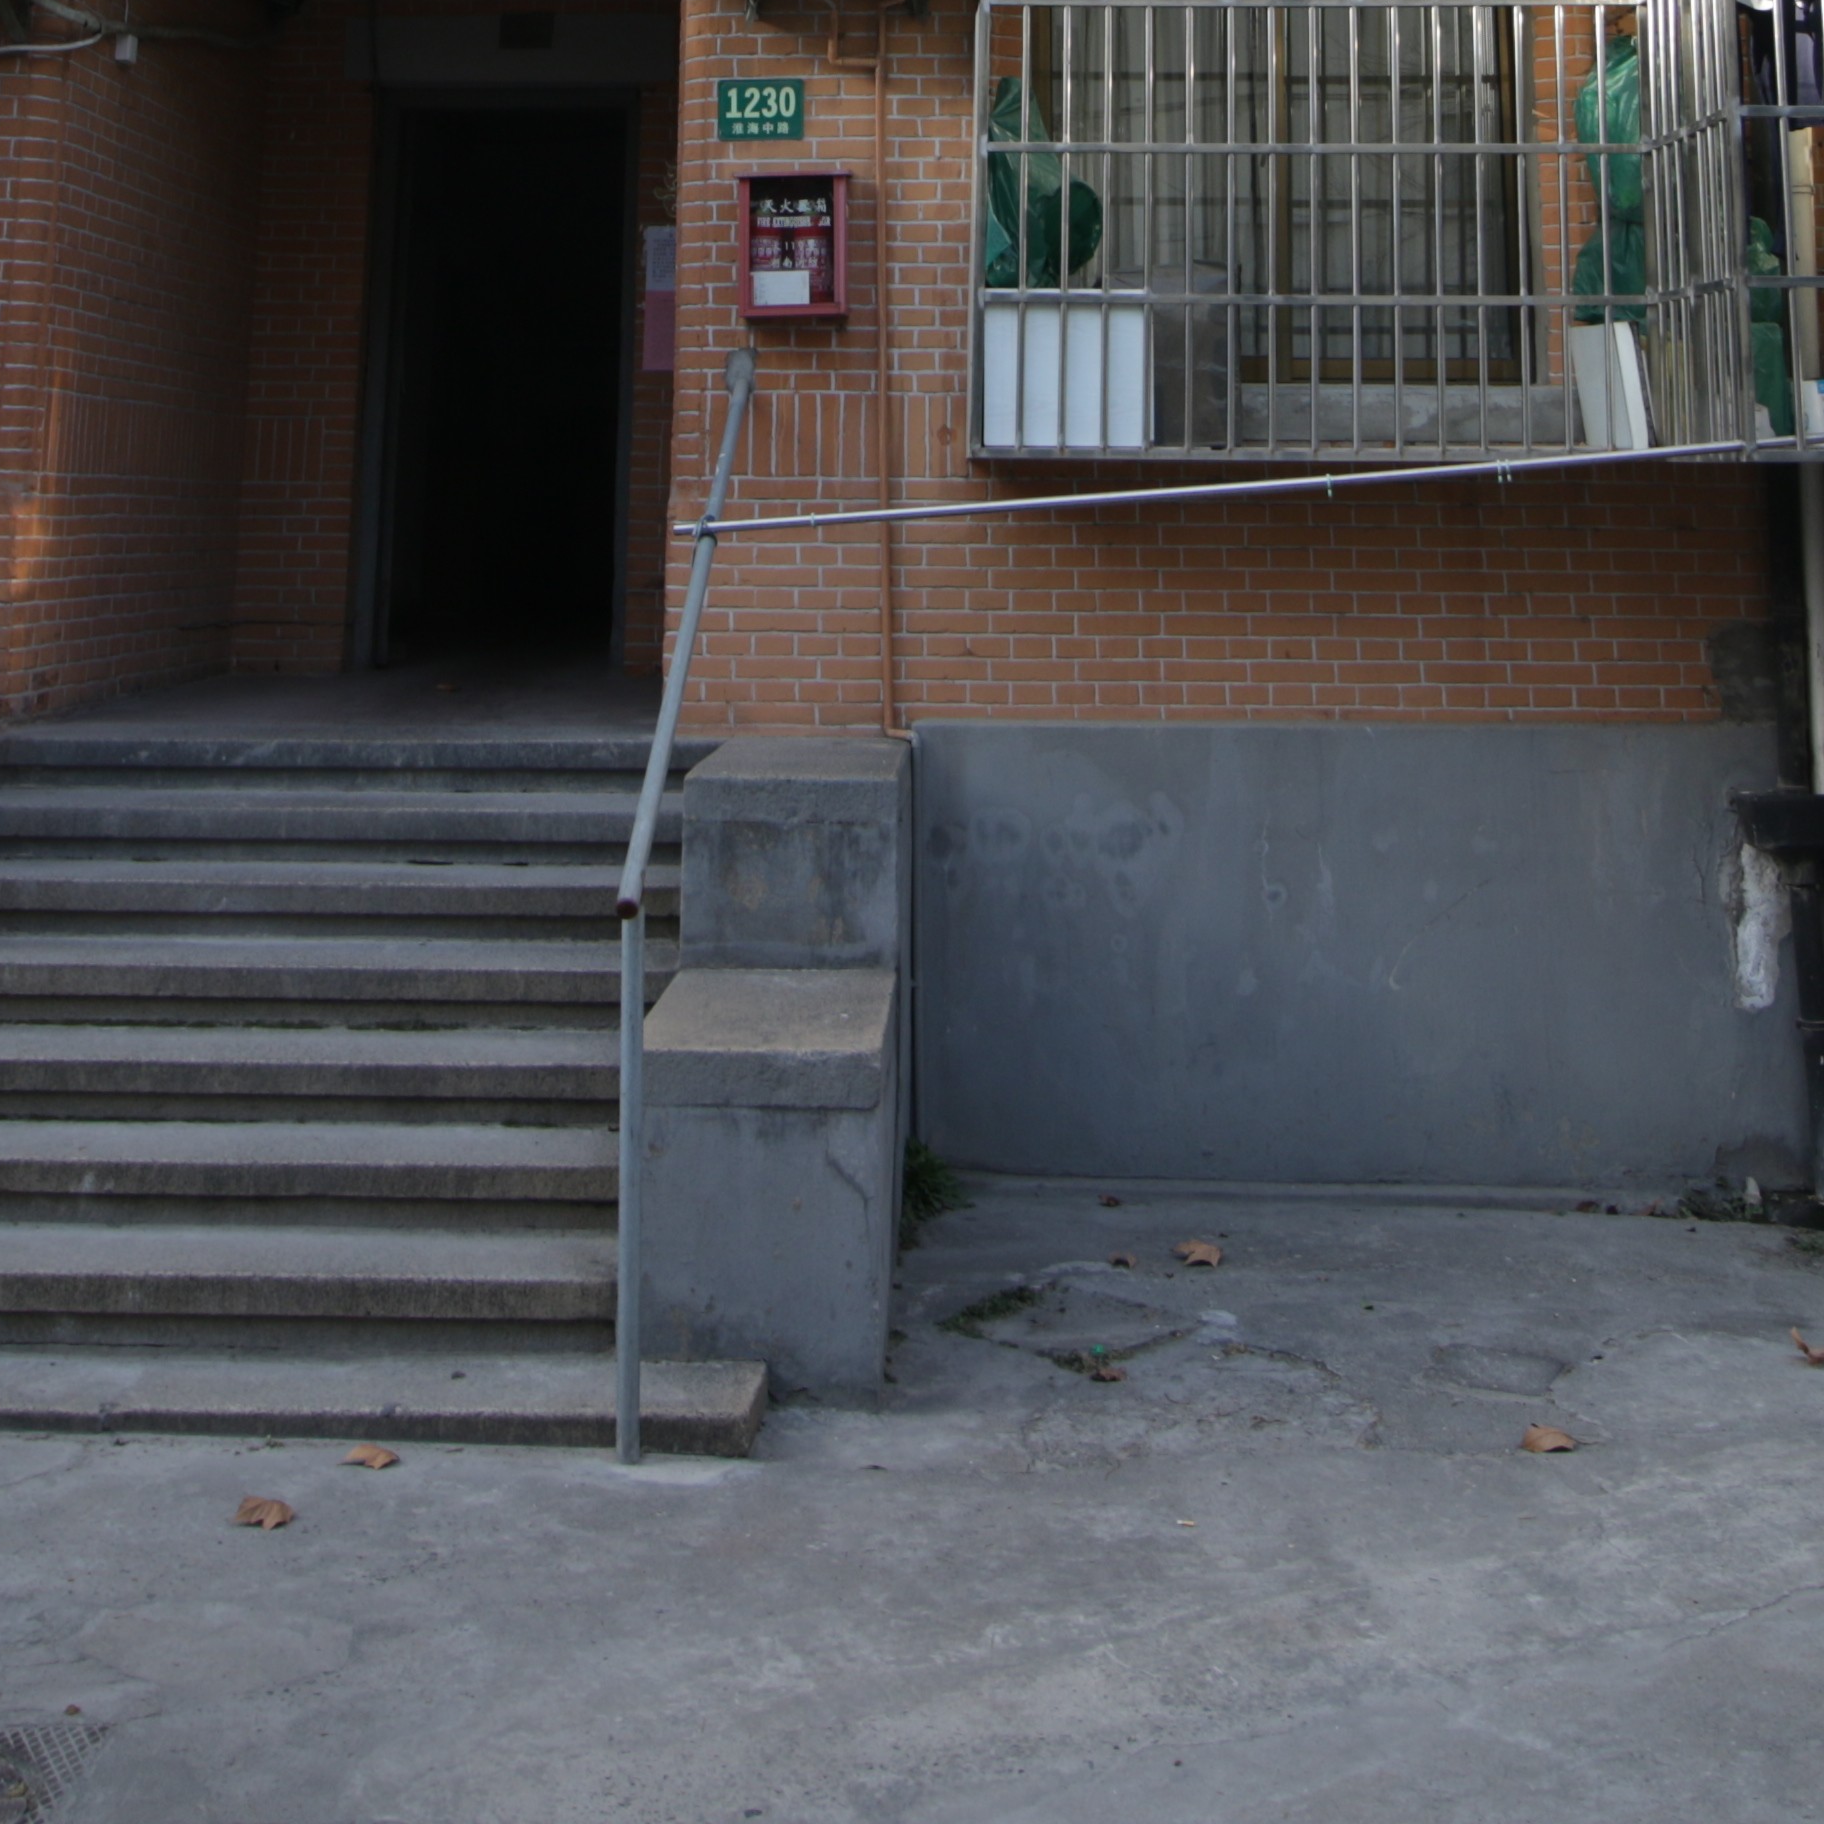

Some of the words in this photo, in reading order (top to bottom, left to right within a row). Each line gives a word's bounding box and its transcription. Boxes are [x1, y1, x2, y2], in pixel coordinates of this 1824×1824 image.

[725, 87, 796, 118] 1230
[731, 121, 790, 135] 淮海中路
